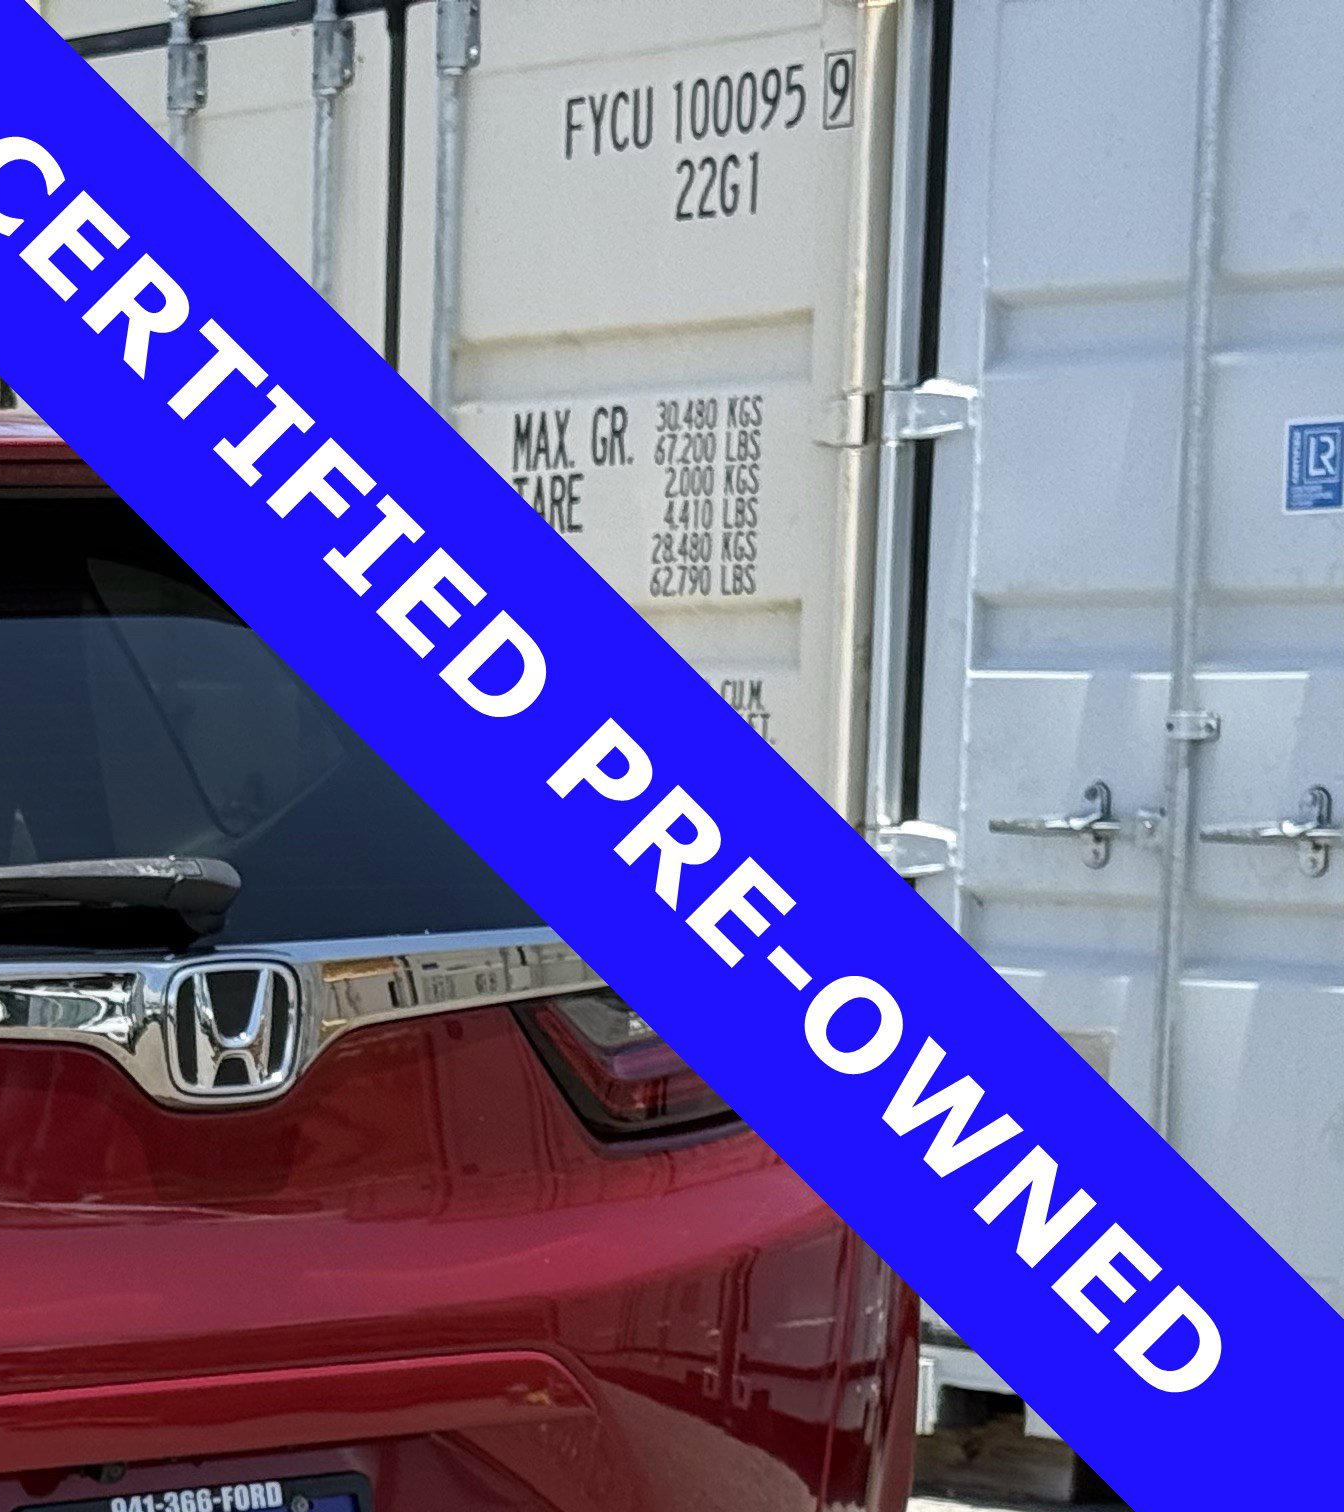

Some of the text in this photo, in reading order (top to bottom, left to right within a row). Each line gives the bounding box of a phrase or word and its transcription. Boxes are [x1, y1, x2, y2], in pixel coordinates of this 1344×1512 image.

[564, 58, 851, 160] FYCU 100095 9
[674, 151, 760, 222] 22G1
[727, 395, 763, 428] KGS
[512, 404, 634, 473] MAX. GR.
[725, 429, 761, 462] LBS
[723, 463, 760, 495] KGS
[722, 496, 759, 529] LBS
[720, 530, 758, 562] KGS
[720, 563, 757, 596] LBS
